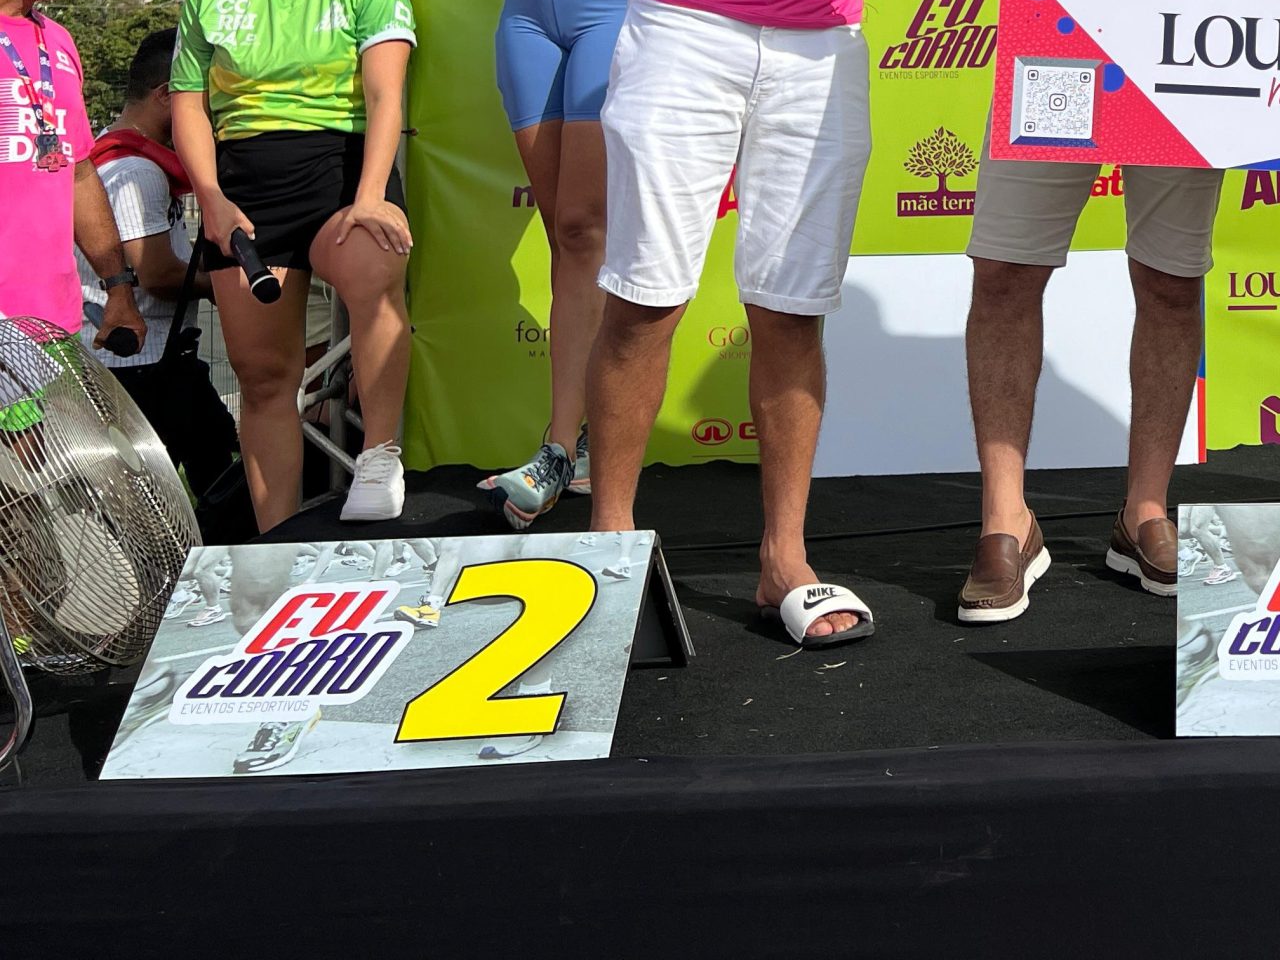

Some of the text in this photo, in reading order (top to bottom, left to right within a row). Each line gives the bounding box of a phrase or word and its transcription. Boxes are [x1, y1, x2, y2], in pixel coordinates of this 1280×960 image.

[878, 24, 998, 69] CORRO
[879, 71, 959, 80] EVENTOS ESPORTIVOS
[900, 194, 975, 211] mãe terr
[806, 587, 836, 600] NIKE
[245, 590, 389, 655] EU
[394, 558, 599, 743] 2
[185, 631, 403, 699] CORRO
[1229, 658, 1278, 671] EVENTOS
[180, 699, 309, 715] EVENTOS ESPORTIVOS
